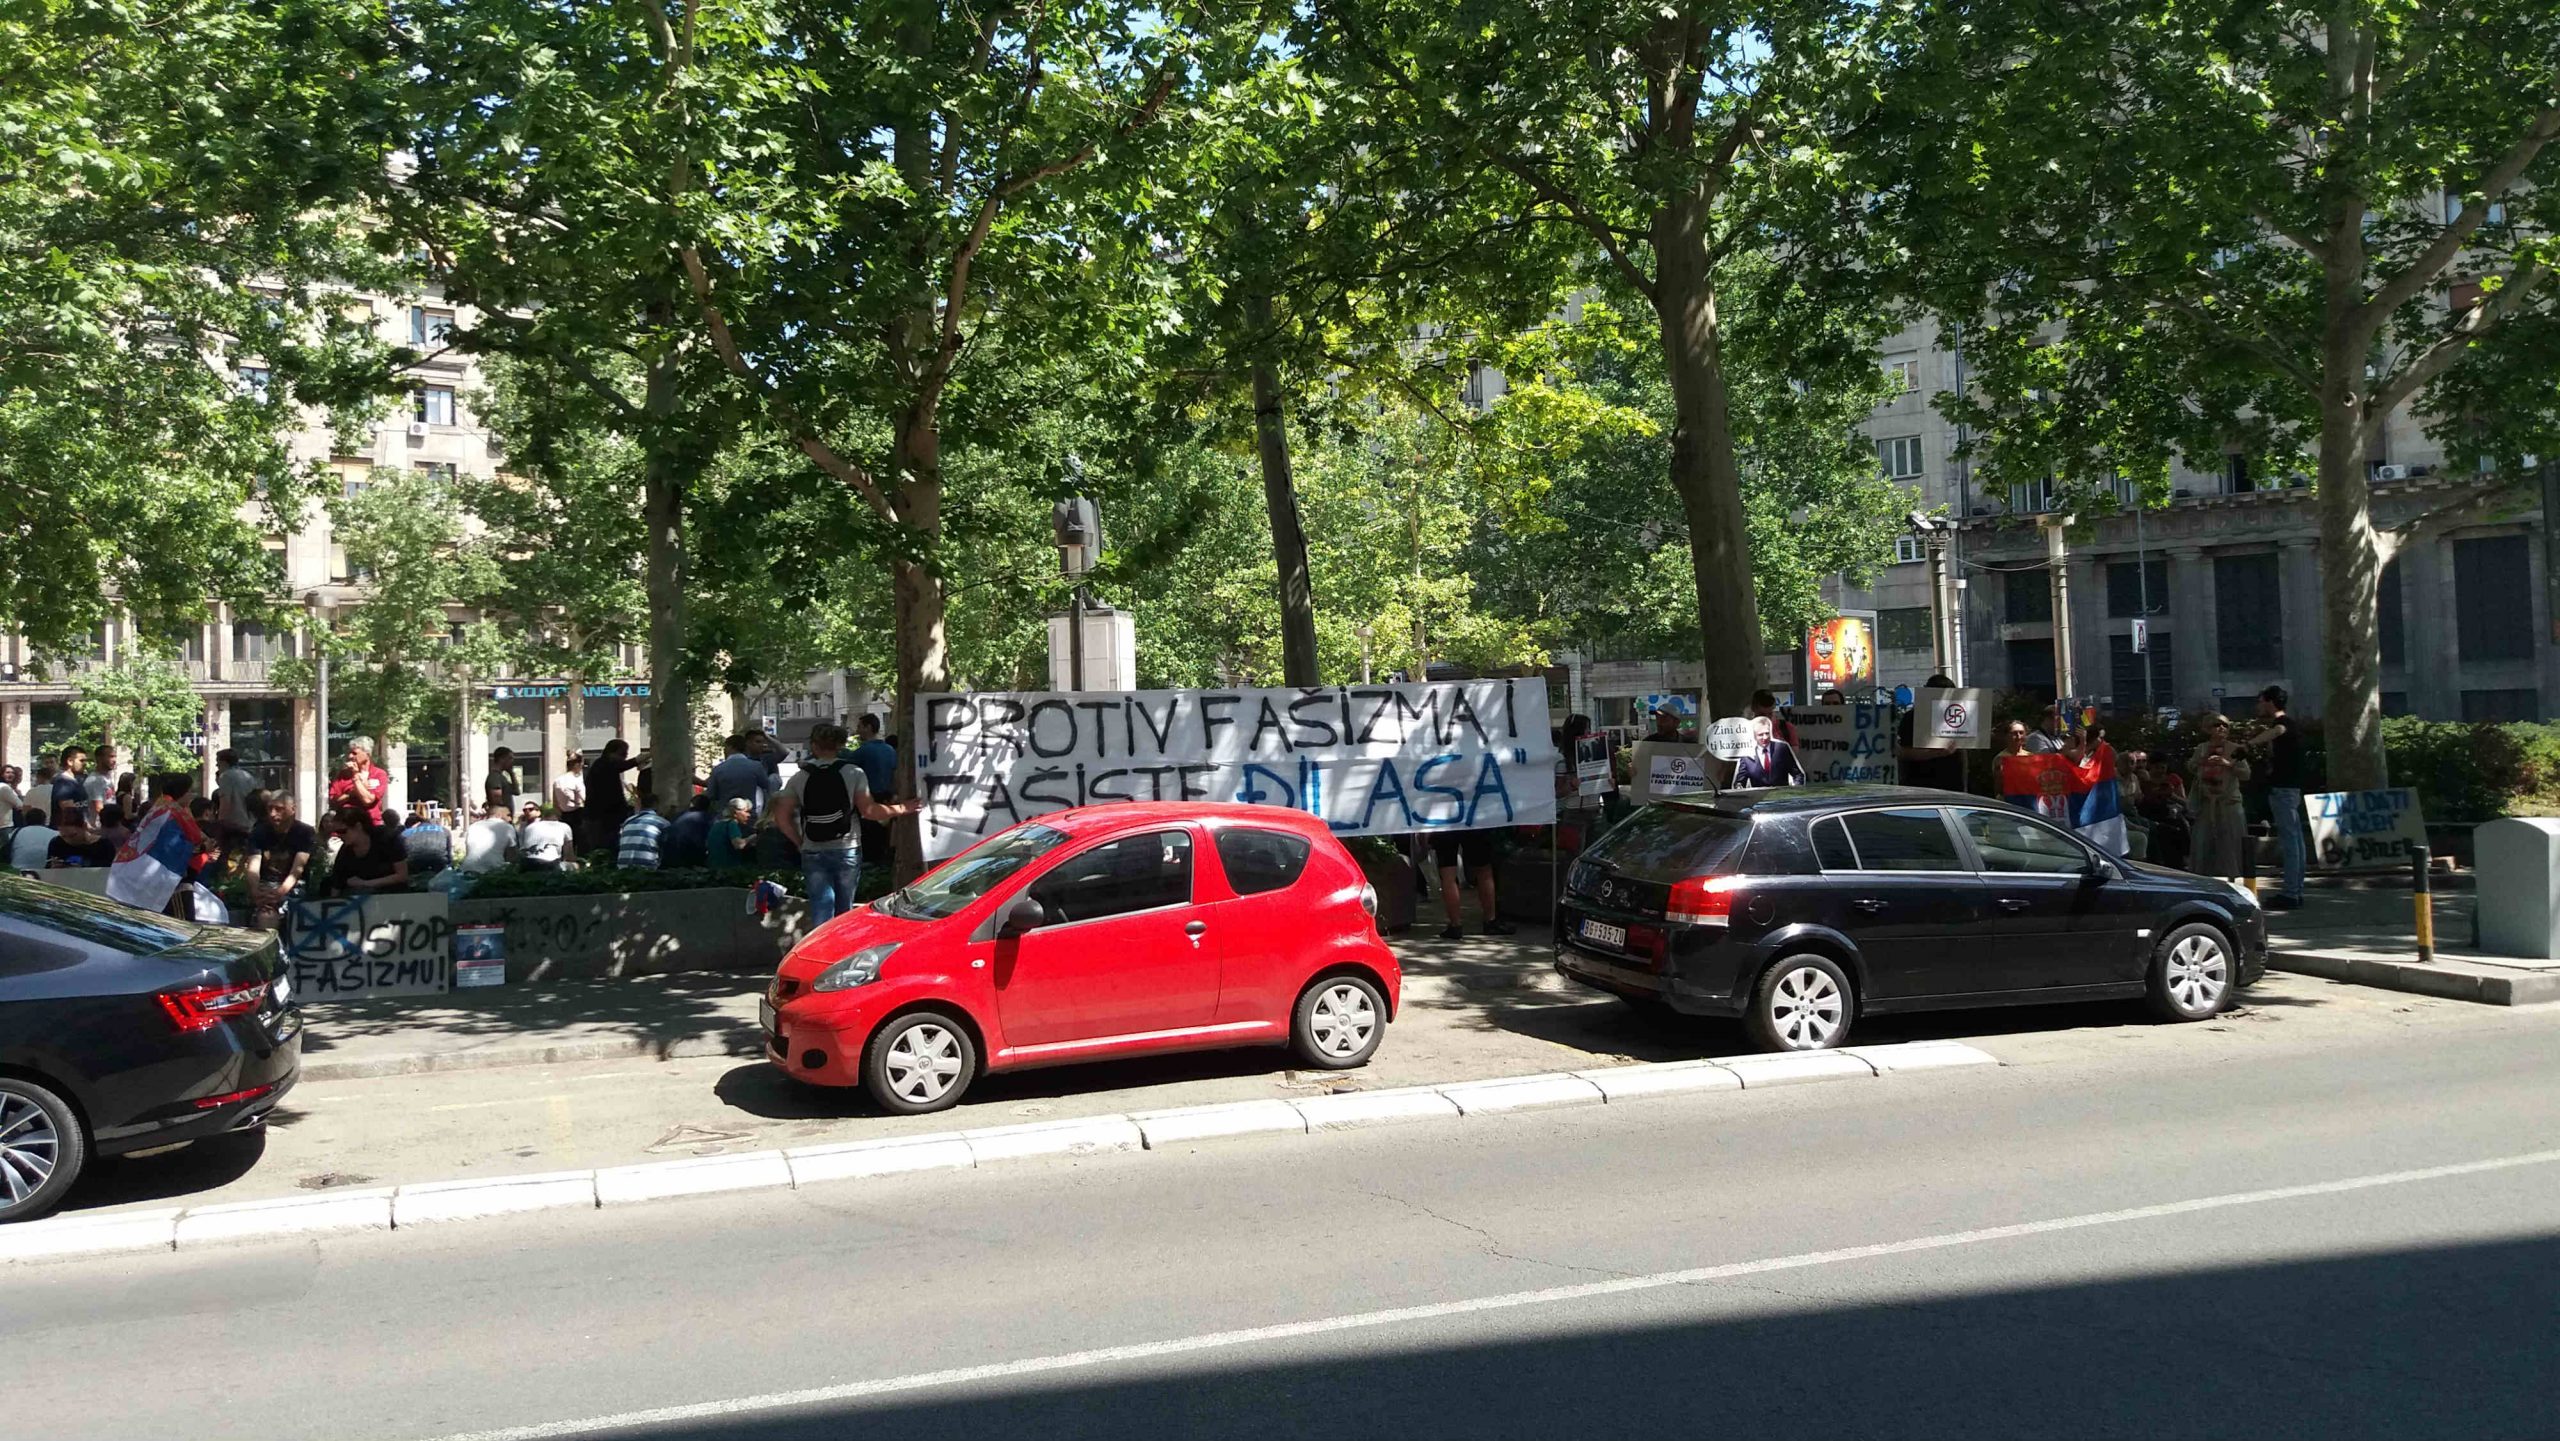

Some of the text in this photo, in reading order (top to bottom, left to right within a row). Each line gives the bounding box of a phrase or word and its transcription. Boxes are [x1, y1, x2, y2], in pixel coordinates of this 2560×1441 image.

[927, 695, 1178, 762] PROTIV
[1200, 686, 1489, 753] FAŠIZMA
[1713, 724, 1747, 735] Zini da
[1710, 740, 1717, 751] ti
[366, 915, 454, 959] STOP
[1584, 921, 1594, 936] BG
[294, 955, 446, 995] FAŠIZMU!
